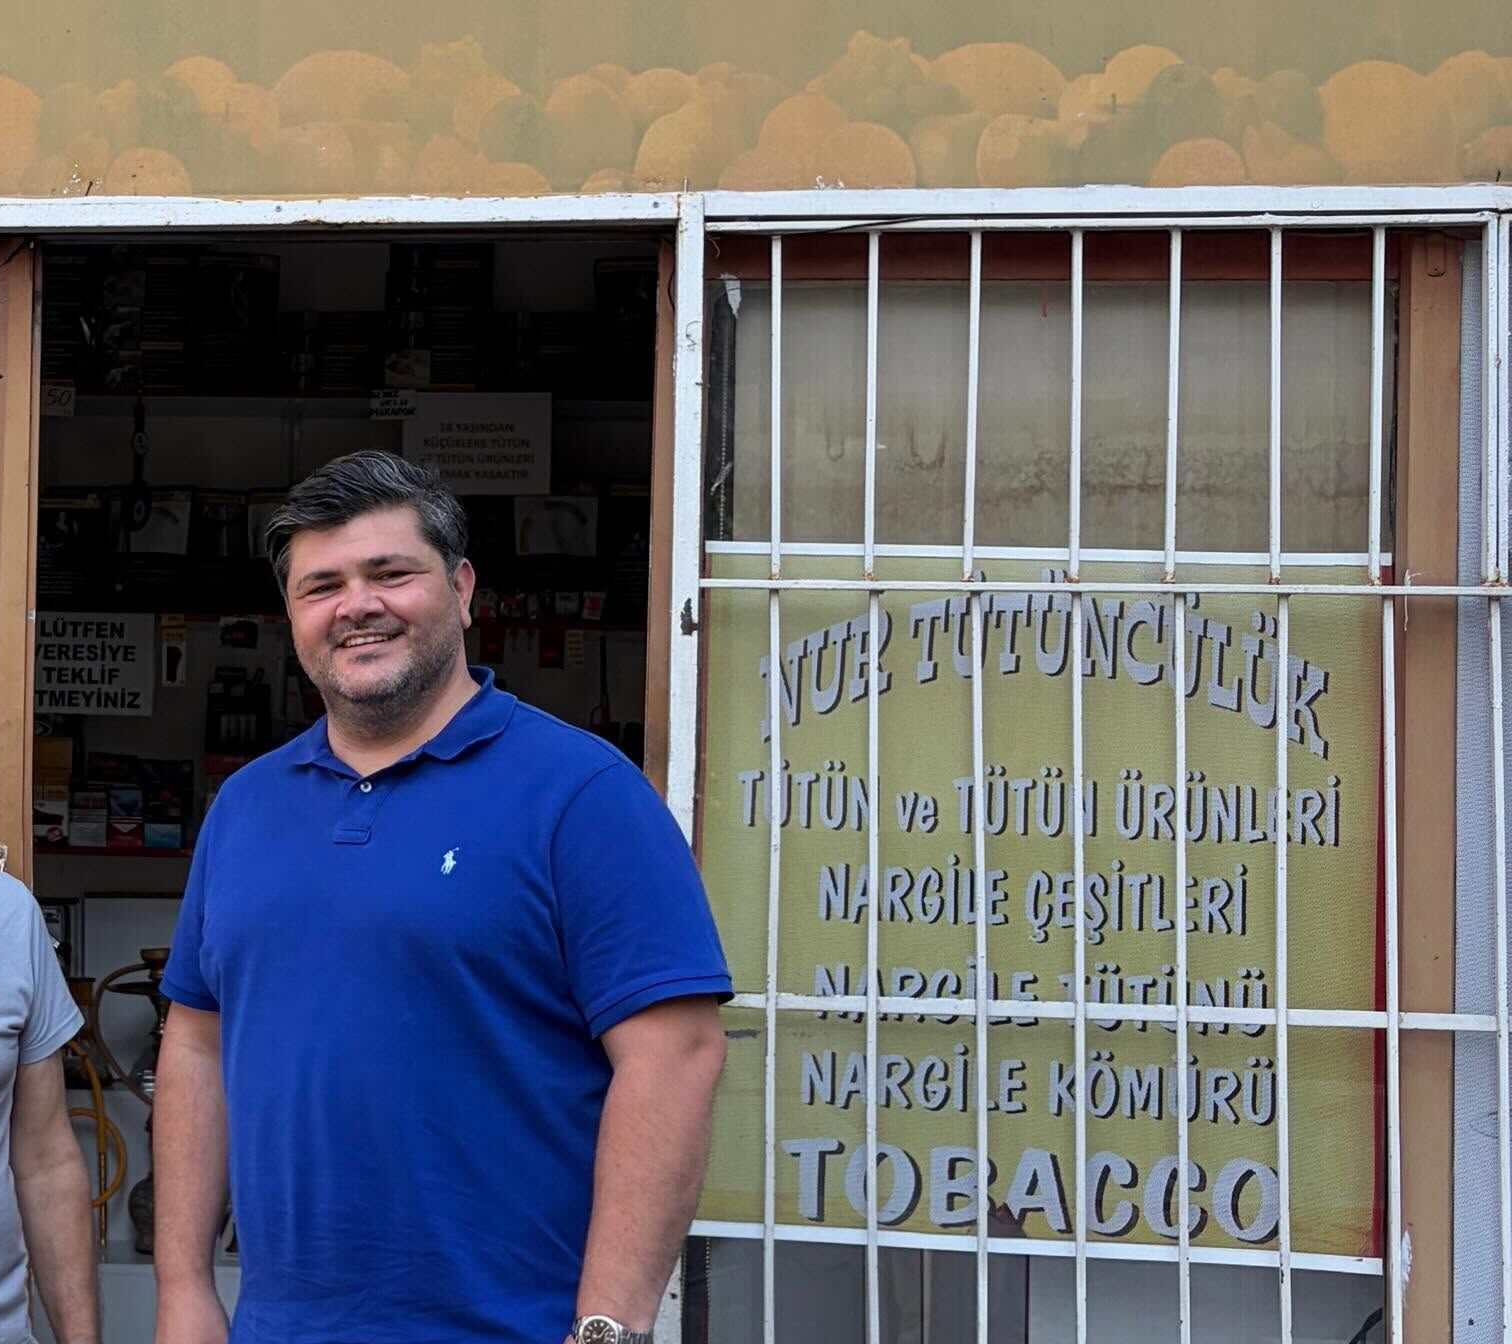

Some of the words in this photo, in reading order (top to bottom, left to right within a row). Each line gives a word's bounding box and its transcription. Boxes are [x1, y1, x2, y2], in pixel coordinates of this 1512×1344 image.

[39, 617, 125, 639] LÜTFEN
[760, 603, 892, 743] NUR
[910, 565, 1329, 760] TÜTÜNCÜLÜK
[35, 687, 141, 709] TMEYİNİZ
[42, 663, 120, 685] TEKLİF
[738, 759, 880, 831] TÜTÜN
[896, 791, 937, 833] ve
[953, 764, 1096, 838] TÜTÜN
[1115, 768, 1340, 847] ÜRÜNLERİ
[818, 854, 1008, 926] NARGİLE
[1025, 859, 1247, 946] ÇEŞİTLERİ
[814, 955, 1038, 1026] NARGİLE
[1049, 1049, 1276, 1126] KÖMÜRÜ
[782, 1138, 1280, 1243] TOBACCO
